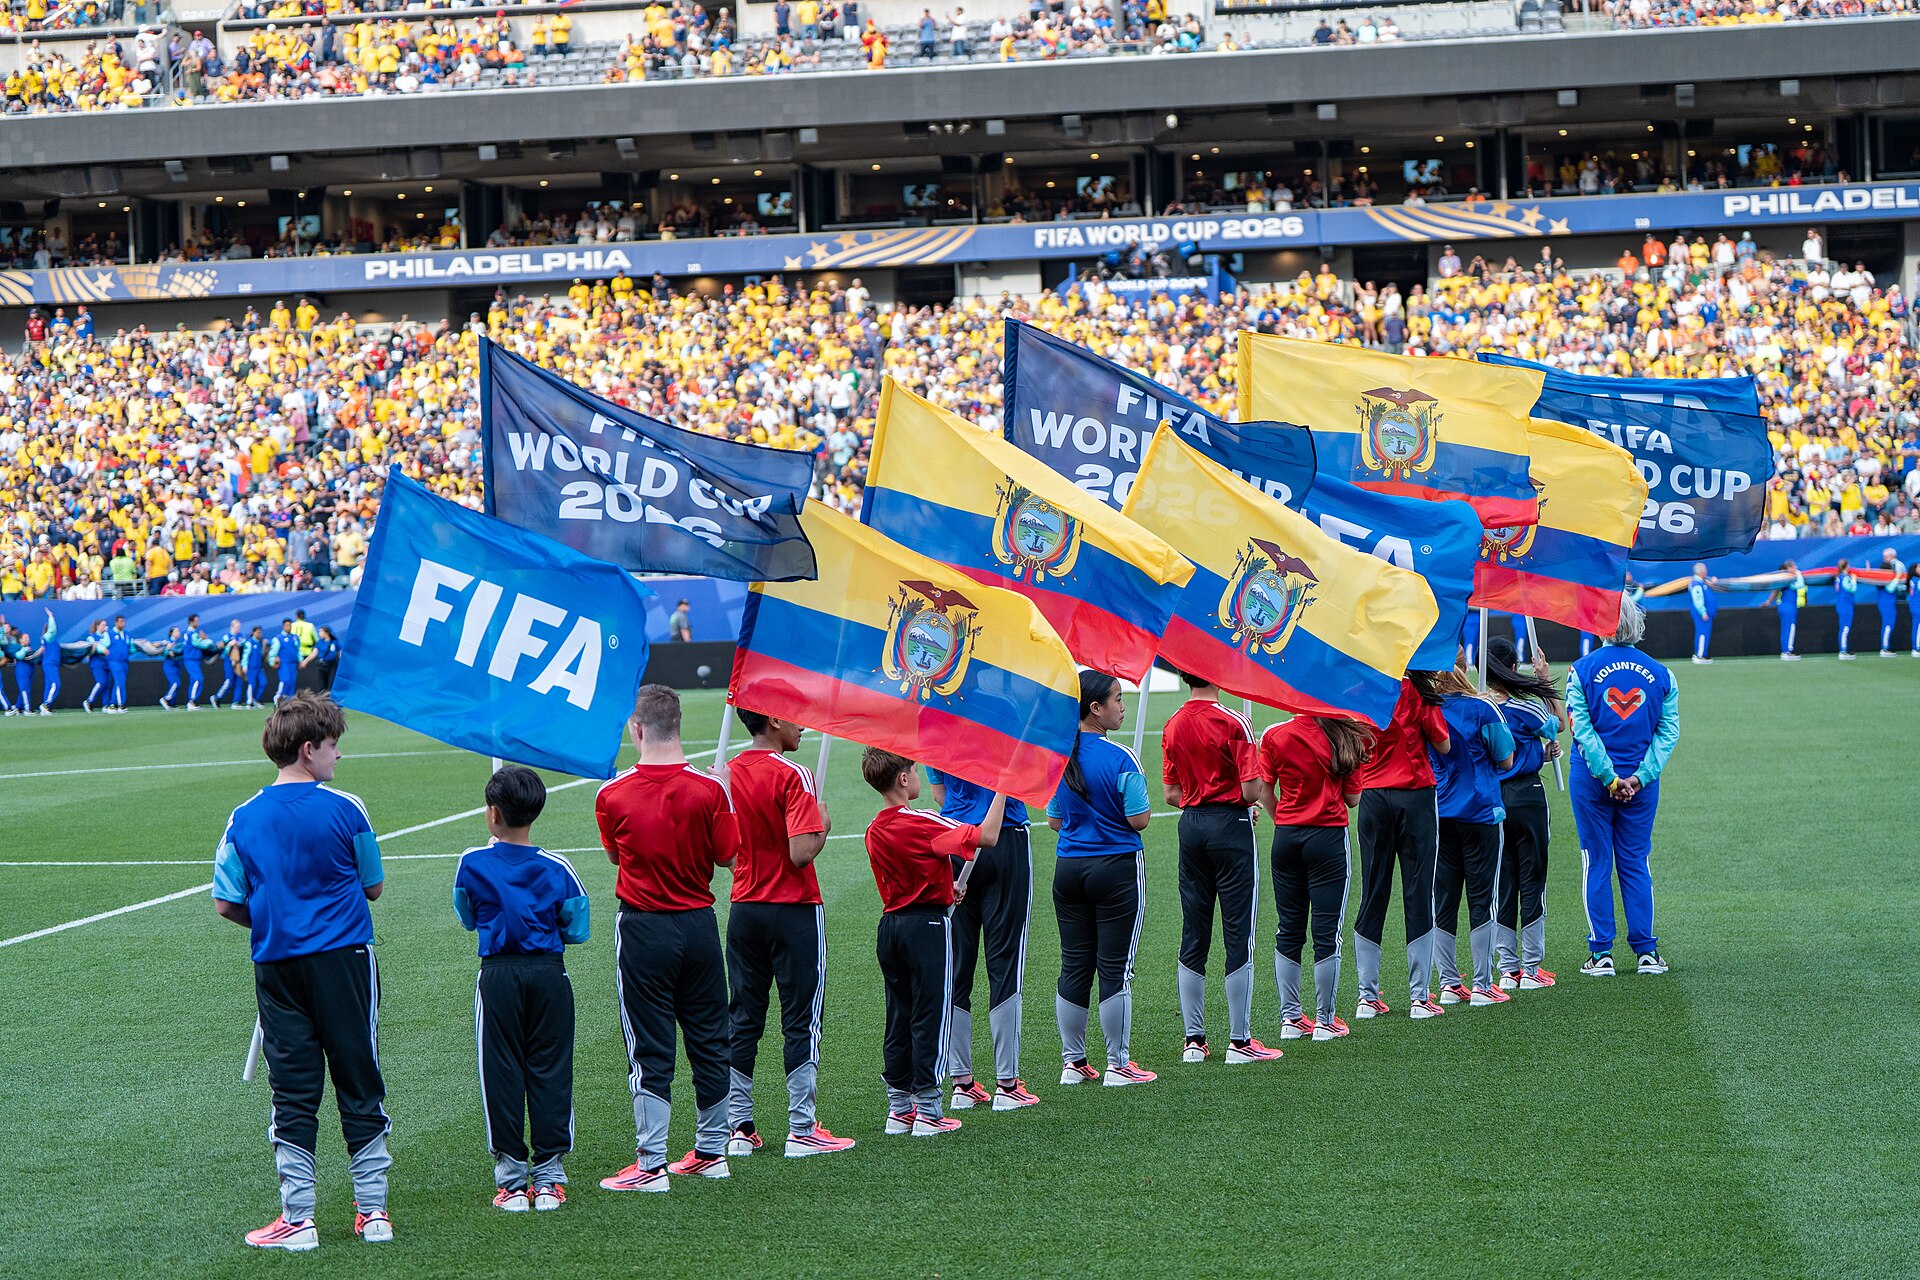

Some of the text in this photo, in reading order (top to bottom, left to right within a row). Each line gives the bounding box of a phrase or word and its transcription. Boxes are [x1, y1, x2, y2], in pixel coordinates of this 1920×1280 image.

[1723, 187, 1920, 217] PHILADEL
[1034, 216, 1304, 248] FIFA WORLD CUP 2026
[364, 249, 632, 280] PHILADELPHIA
[1115, 383, 1212, 446] FIFA
[1586, 419, 1674, 455] FIFA
[507, 432, 679, 498] WORLD
[1669, 464, 1752, 501] CUP
[398, 557, 602, 711] FIFA
[1593, 661, 1656, 684] VOLUNTEER
